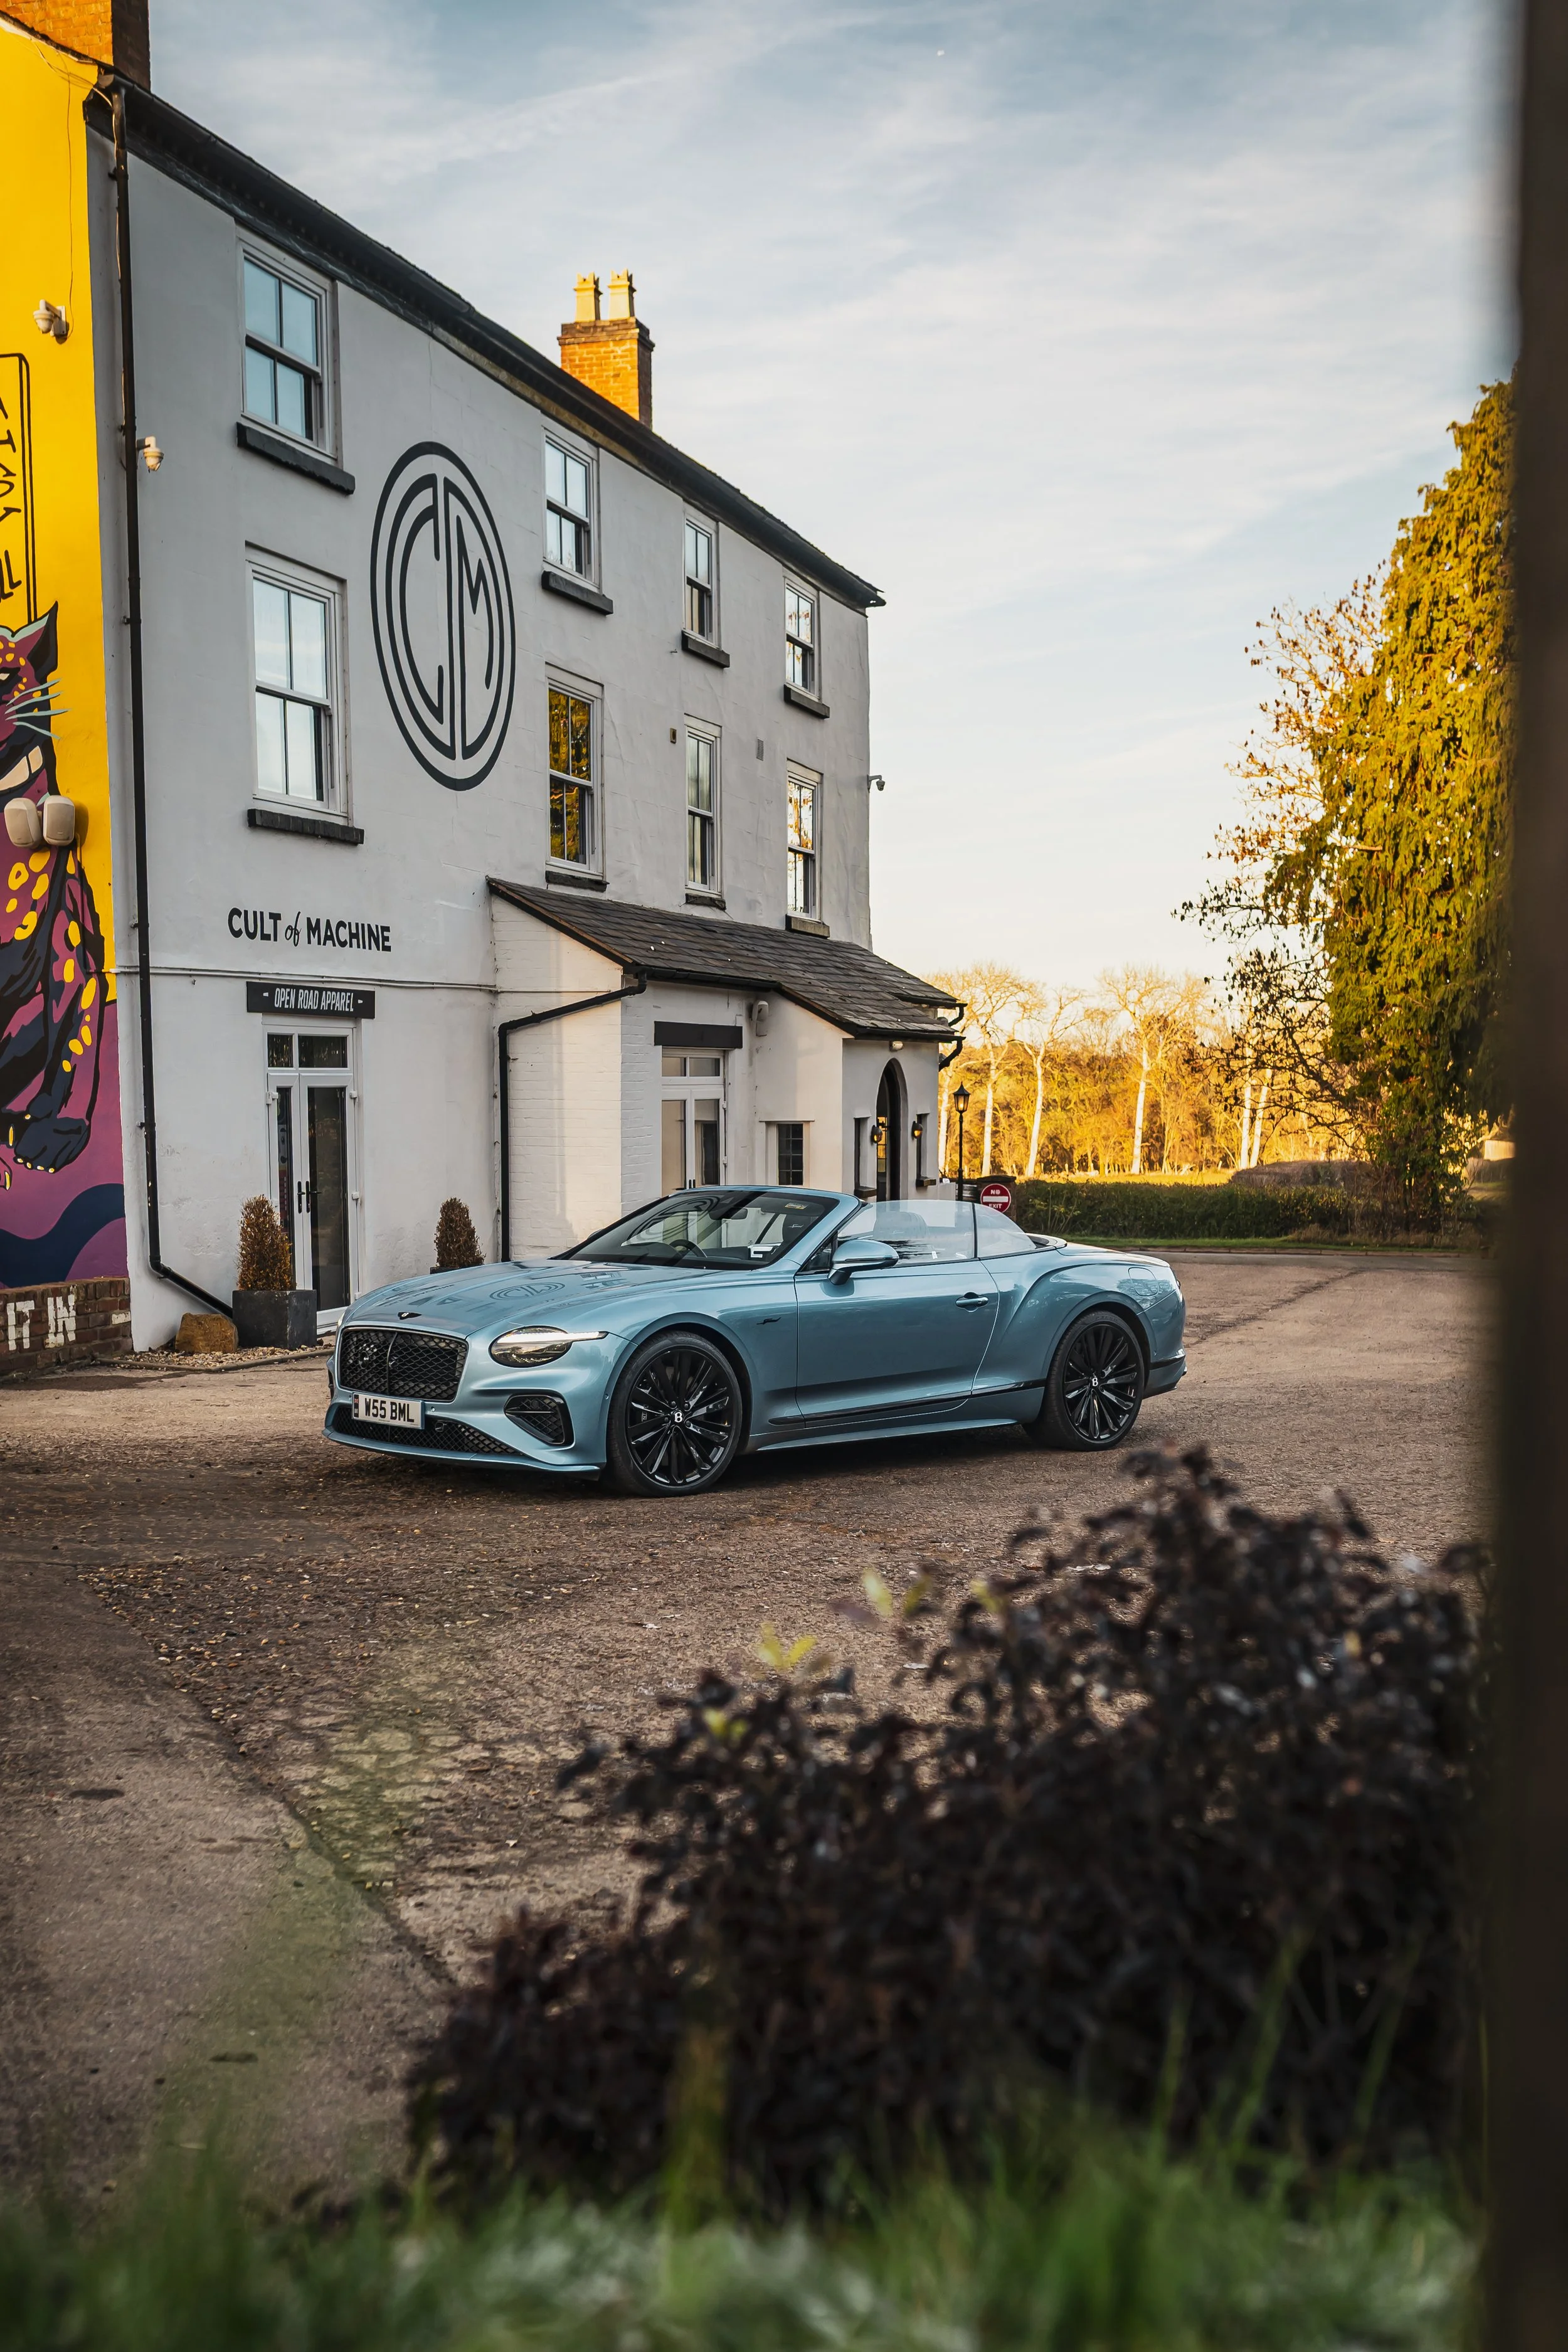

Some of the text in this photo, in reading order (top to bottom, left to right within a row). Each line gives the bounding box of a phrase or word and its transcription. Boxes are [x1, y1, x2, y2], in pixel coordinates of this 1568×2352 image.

[227, 907, 392, 953] CULT of MACHINE
[274, 987, 354, 1012] OPEN ROAD APPAREL
[1091, 1377, 1099, 1387] B
[364, 1397, 415, 1423] W55 BML
[674, 1411, 684, 1423] B
